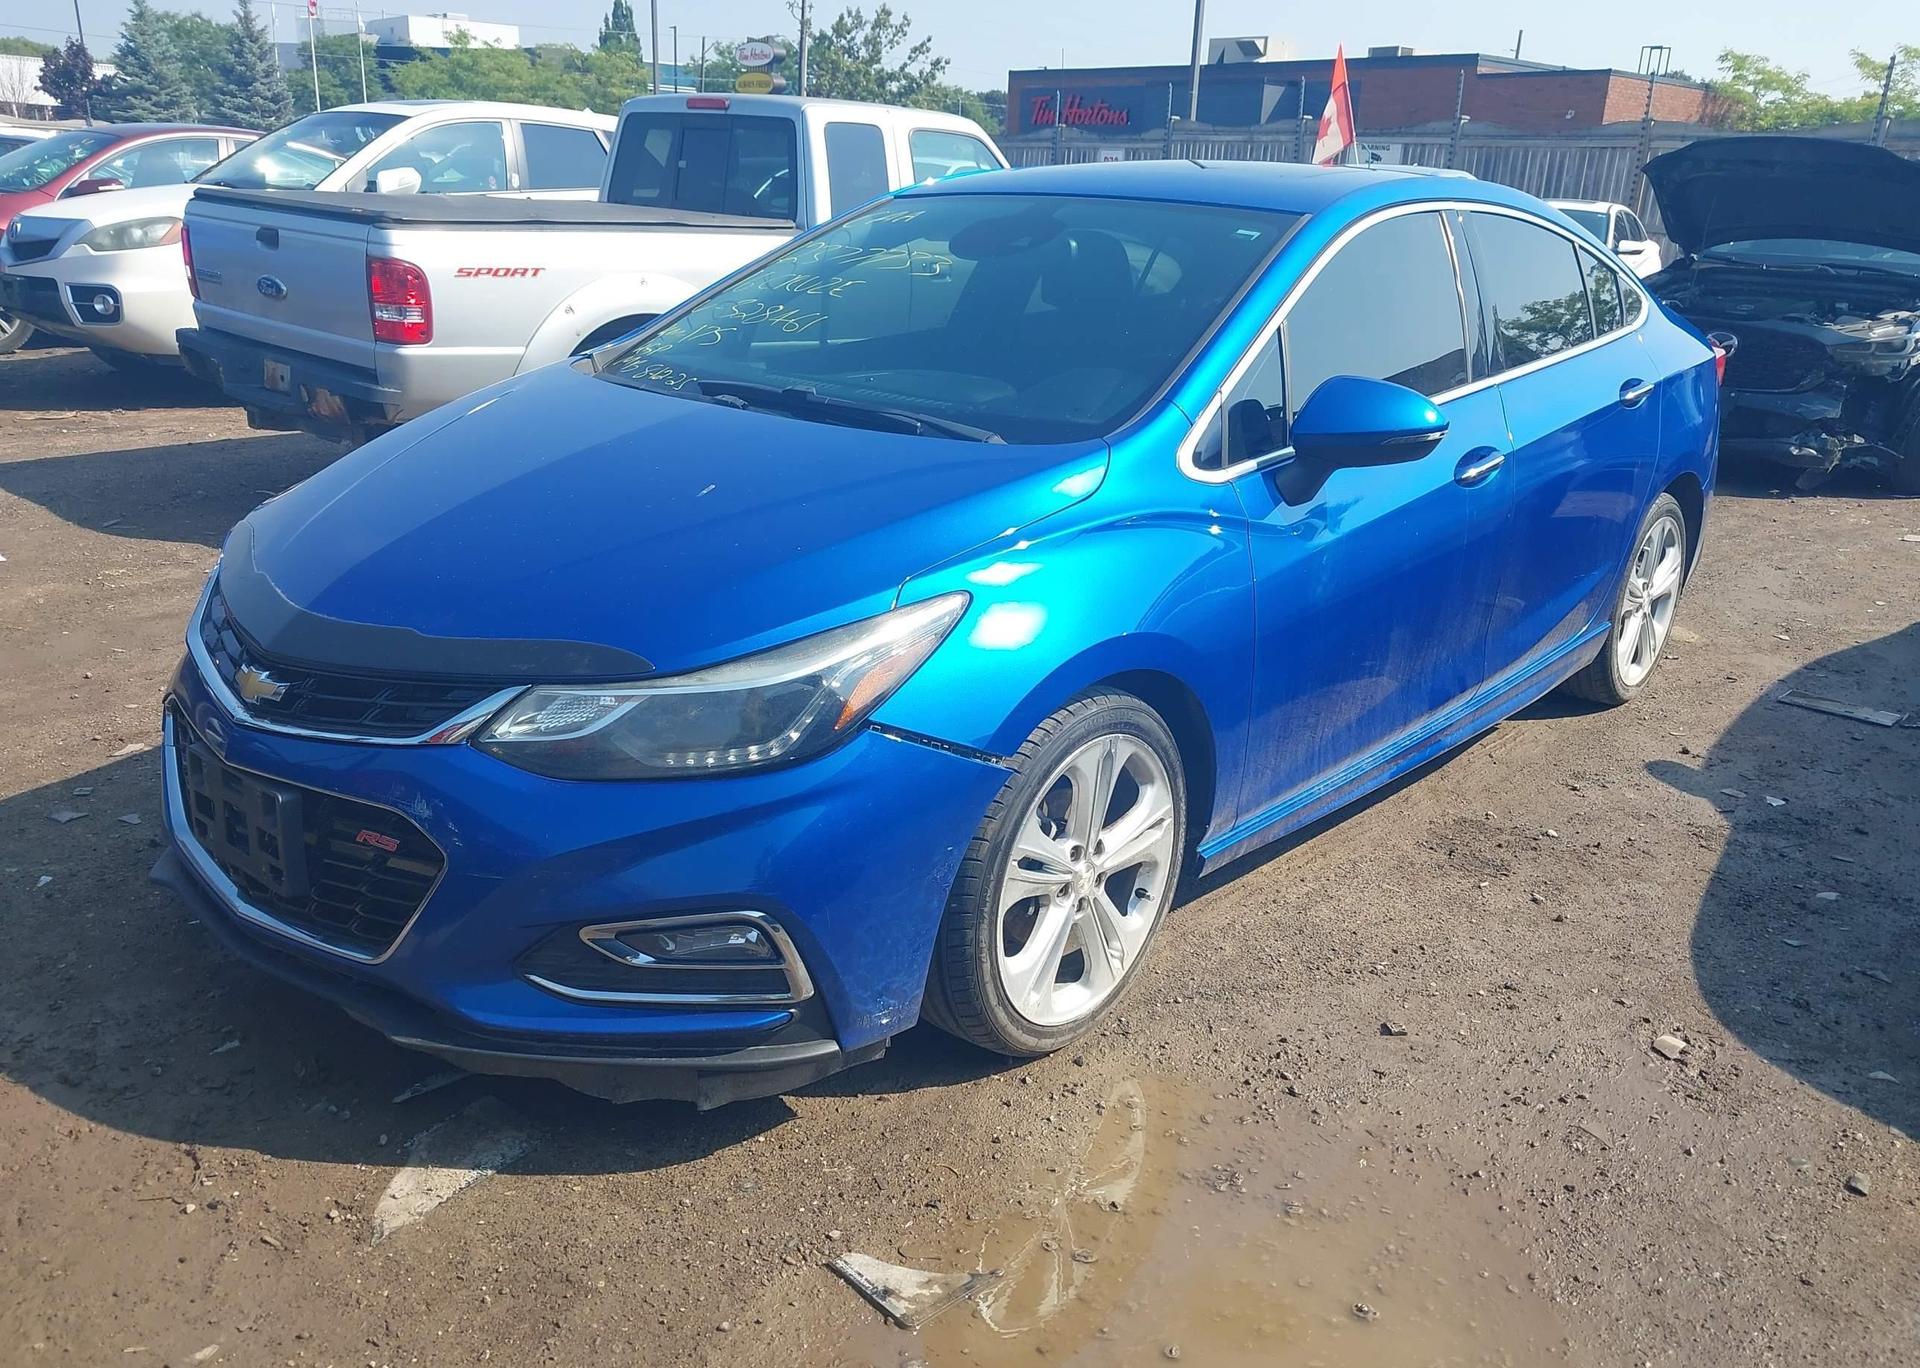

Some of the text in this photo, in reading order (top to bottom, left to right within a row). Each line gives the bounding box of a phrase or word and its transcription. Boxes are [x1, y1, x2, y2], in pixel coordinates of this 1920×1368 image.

[1031, 93, 1129, 126] Tim Hortons
[454, 267, 547, 278] SPORT
[355, 829, 401, 852] RS
